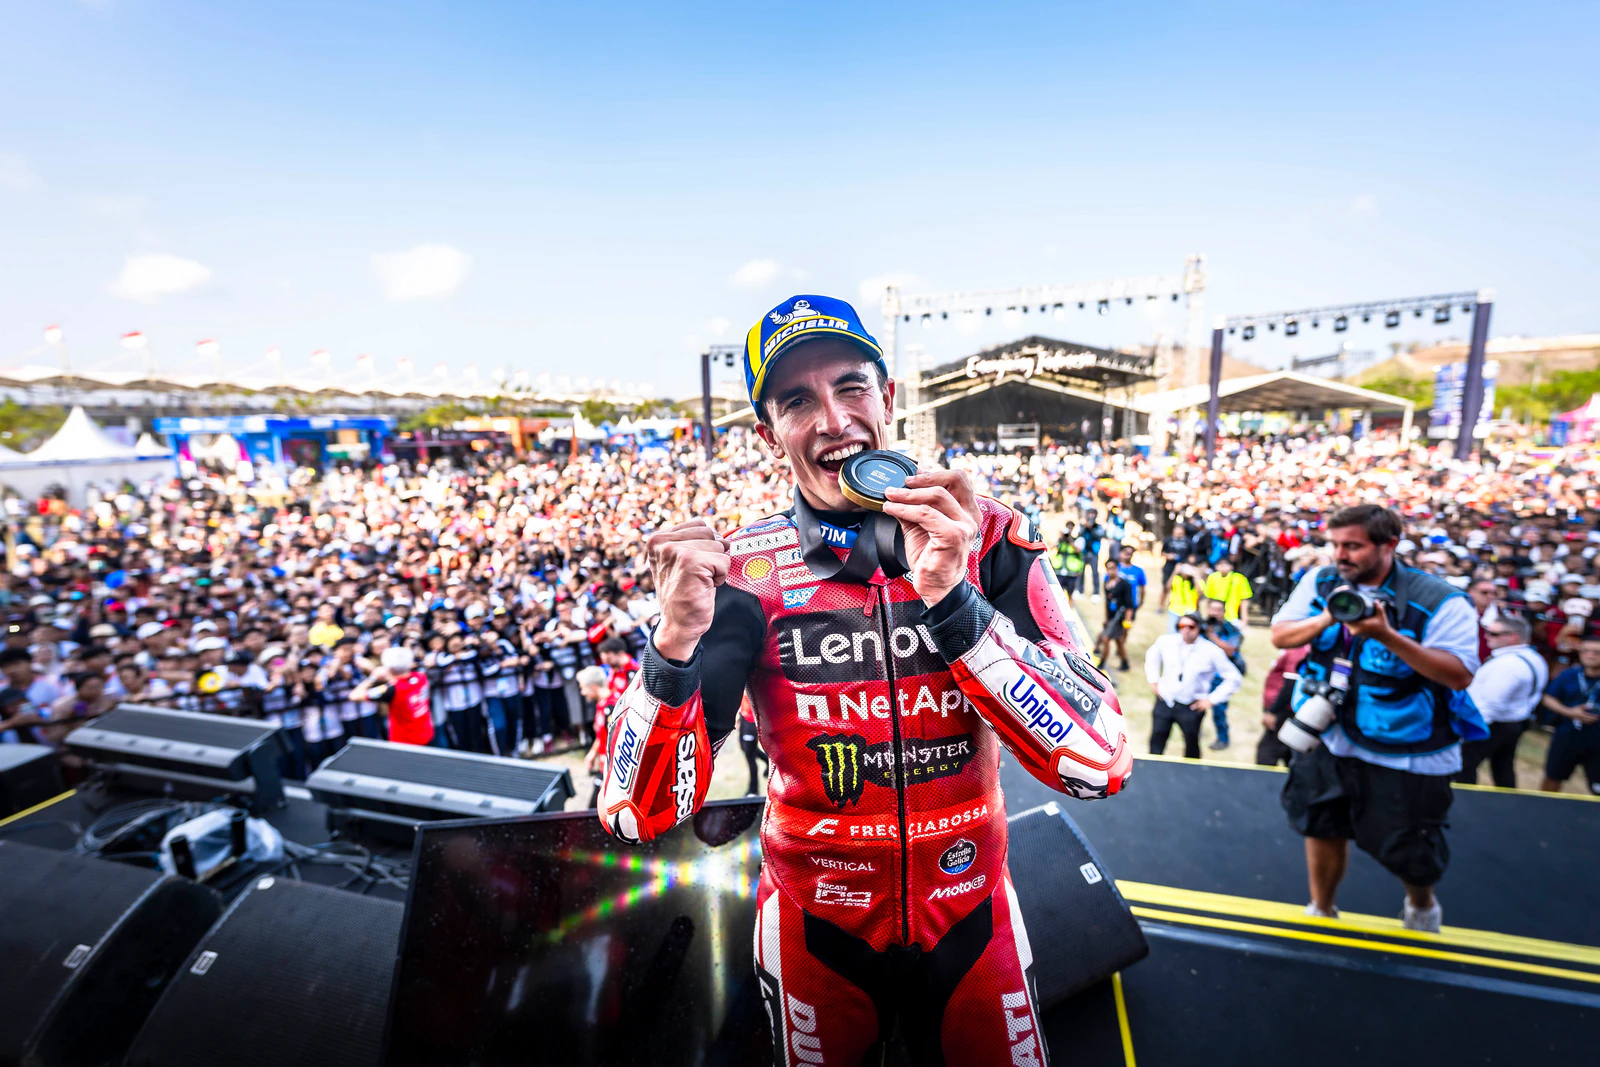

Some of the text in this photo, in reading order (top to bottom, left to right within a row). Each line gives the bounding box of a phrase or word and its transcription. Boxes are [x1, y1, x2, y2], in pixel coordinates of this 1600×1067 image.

[764, 319, 849, 358] MICHELIN
[736, 535, 790, 551] EATALY
[820, 525, 847, 545] TIM
[783, 591, 809, 606] SAP
[1031, 653, 1094, 712] Lenovo
[1010, 674, 1074, 744] Unipol
[862, 741, 970, 770] MONSTER
[849, 804, 988, 838] FRECCIAROSSA
[810, 857, 876, 872] VERTICAL
[947, 847, 972, 860] Estrella
[947, 856, 970, 868] Galicia
[817, 881, 848, 891] DUCATI
[927, 874, 986, 901] MotoGP
[787, 992, 824, 1067] DU
